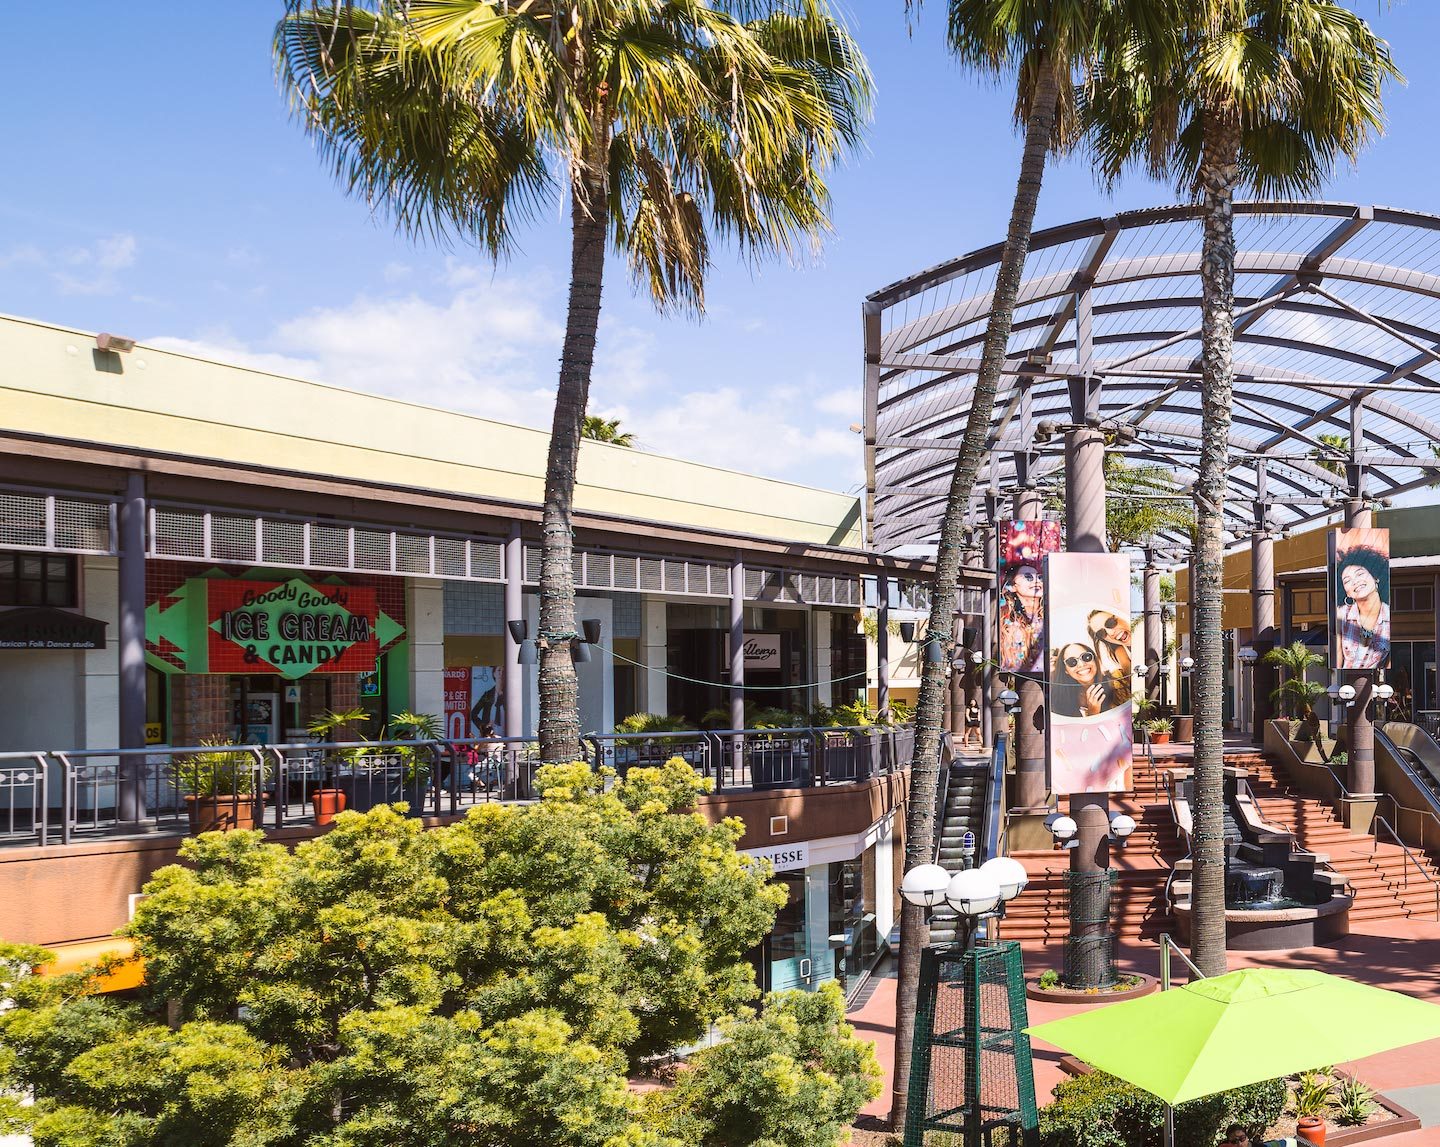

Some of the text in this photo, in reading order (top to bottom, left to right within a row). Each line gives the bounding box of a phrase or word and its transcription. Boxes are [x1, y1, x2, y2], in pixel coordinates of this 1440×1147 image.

[243, 583, 348, 608] Goody Goody
[221, 611, 370, 642] ICE CREAM
[0, 640, 95, 648] exican Folk Dance studio
[243, 644, 348, 665] & CANDY
[743, 637, 777, 661] ellenza
[289, 688, 297, 697] A
[455, 691, 467, 700] GET
